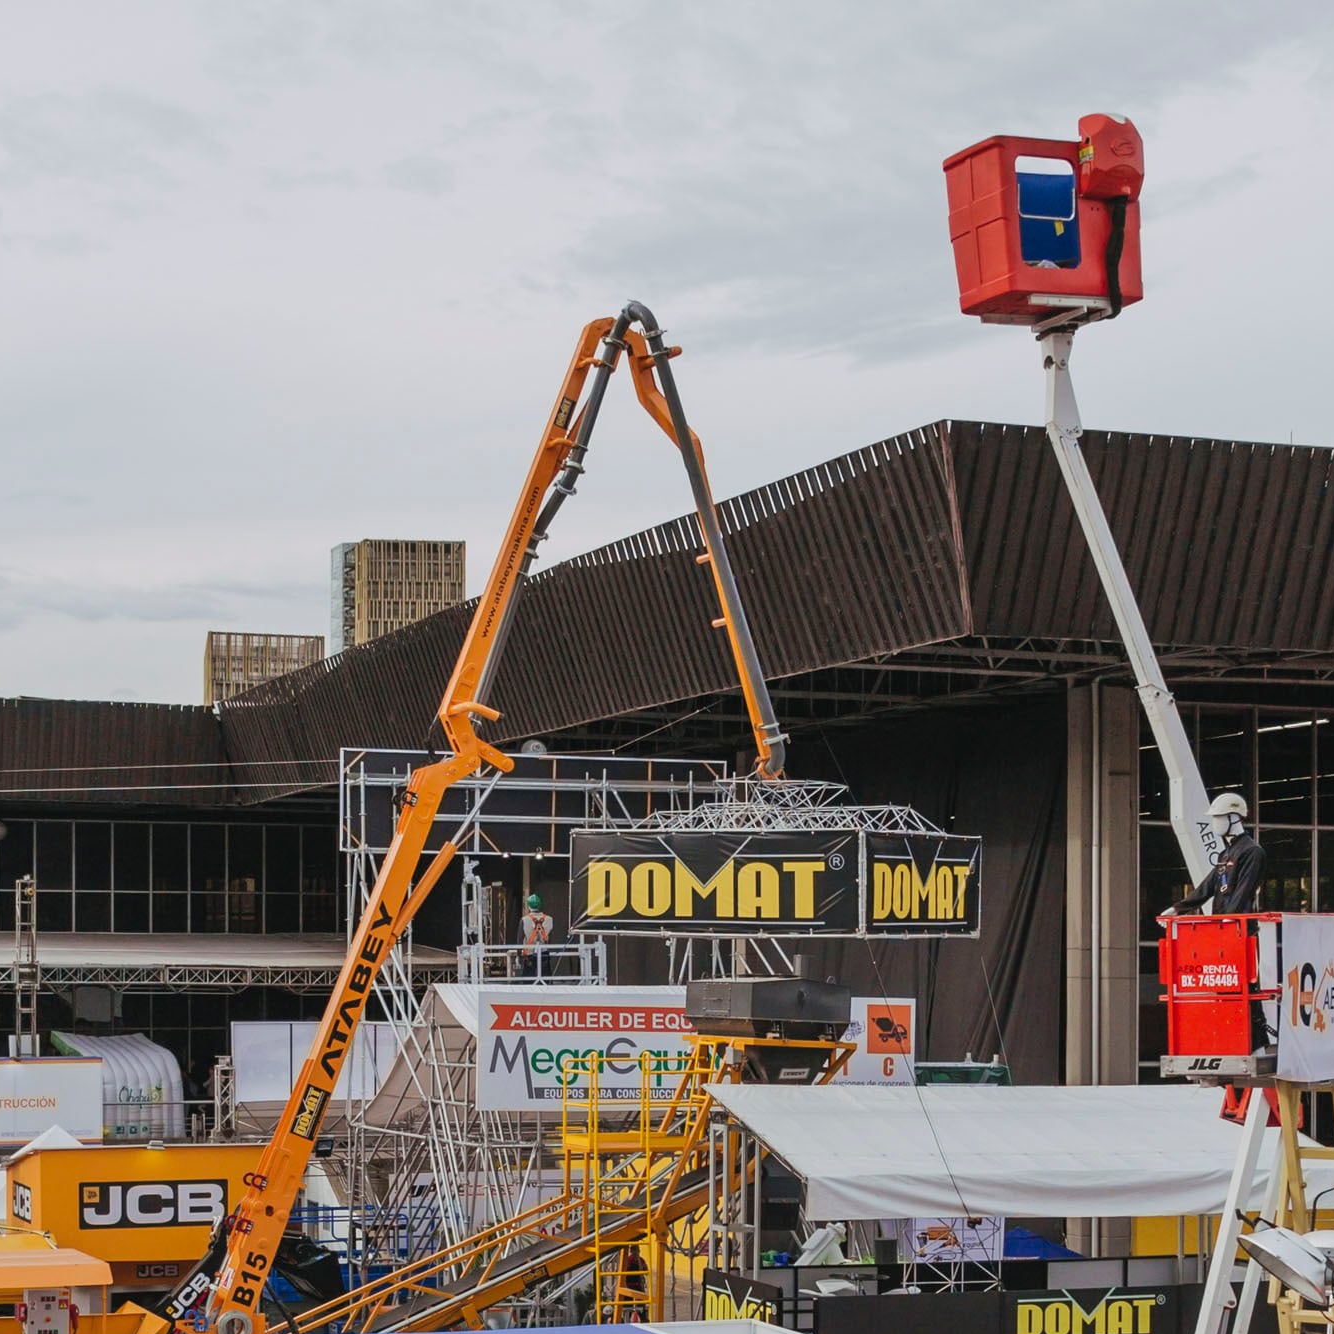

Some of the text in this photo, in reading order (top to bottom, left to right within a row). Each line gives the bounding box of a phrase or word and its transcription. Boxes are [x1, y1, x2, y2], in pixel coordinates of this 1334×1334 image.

[587, 858, 827, 919] DOMAT
[872, 860, 970, 920] DOMAT
[318, 900, 395, 1080] ATABEY
[1177, 964, 1239, 974] AERORENTAL
[1181, 974, 1239, 988] BX: 7454484
[510, 1010, 613, 1029] ALQUILER
[618, 1012, 646, 1029] DE
[1188, 1058, 1223, 1071] JLG
[13, 1182, 33, 1224] JCB
[82, 1183, 225, 1227] JCB
[137, 1263, 178, 1278] JCB
[231, 1250, 267, 1308] B15
[170, 1272, 211, 1320] JCB
